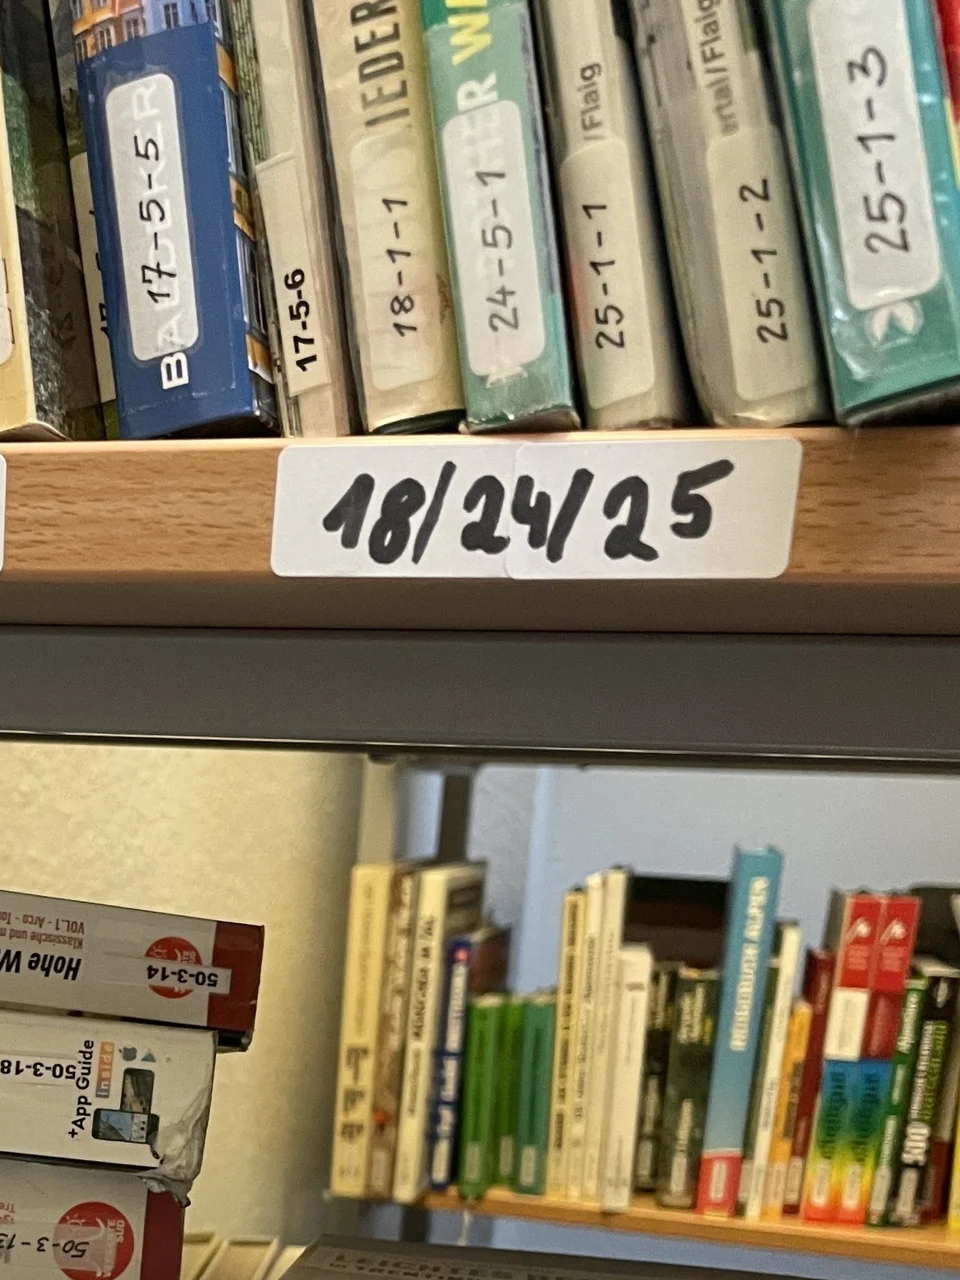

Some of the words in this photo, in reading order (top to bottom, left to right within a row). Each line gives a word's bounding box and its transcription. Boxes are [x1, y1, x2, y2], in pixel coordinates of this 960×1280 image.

[846, 45, 912, 254] 25-1-3
[134, 135, 177, 304] 17-5-5
[381, 197, 417, 338] 18-1-1
[475, 170, 519, 333] 24-5-1
[582, 202, 625, 350] 25-1-1
[739, 177, 788, 344] 25-1-2
[284, 268, 317, 372] 17-5-6
[322, 459, 735, 565] 18/24/25
[27, 952, 82, 981] Hohe
[146, 964, 219, 988] 50-3-14
[0, 1058, 77, 1080] 50-3-18
[76, 1040, 94, 1090] Guide
